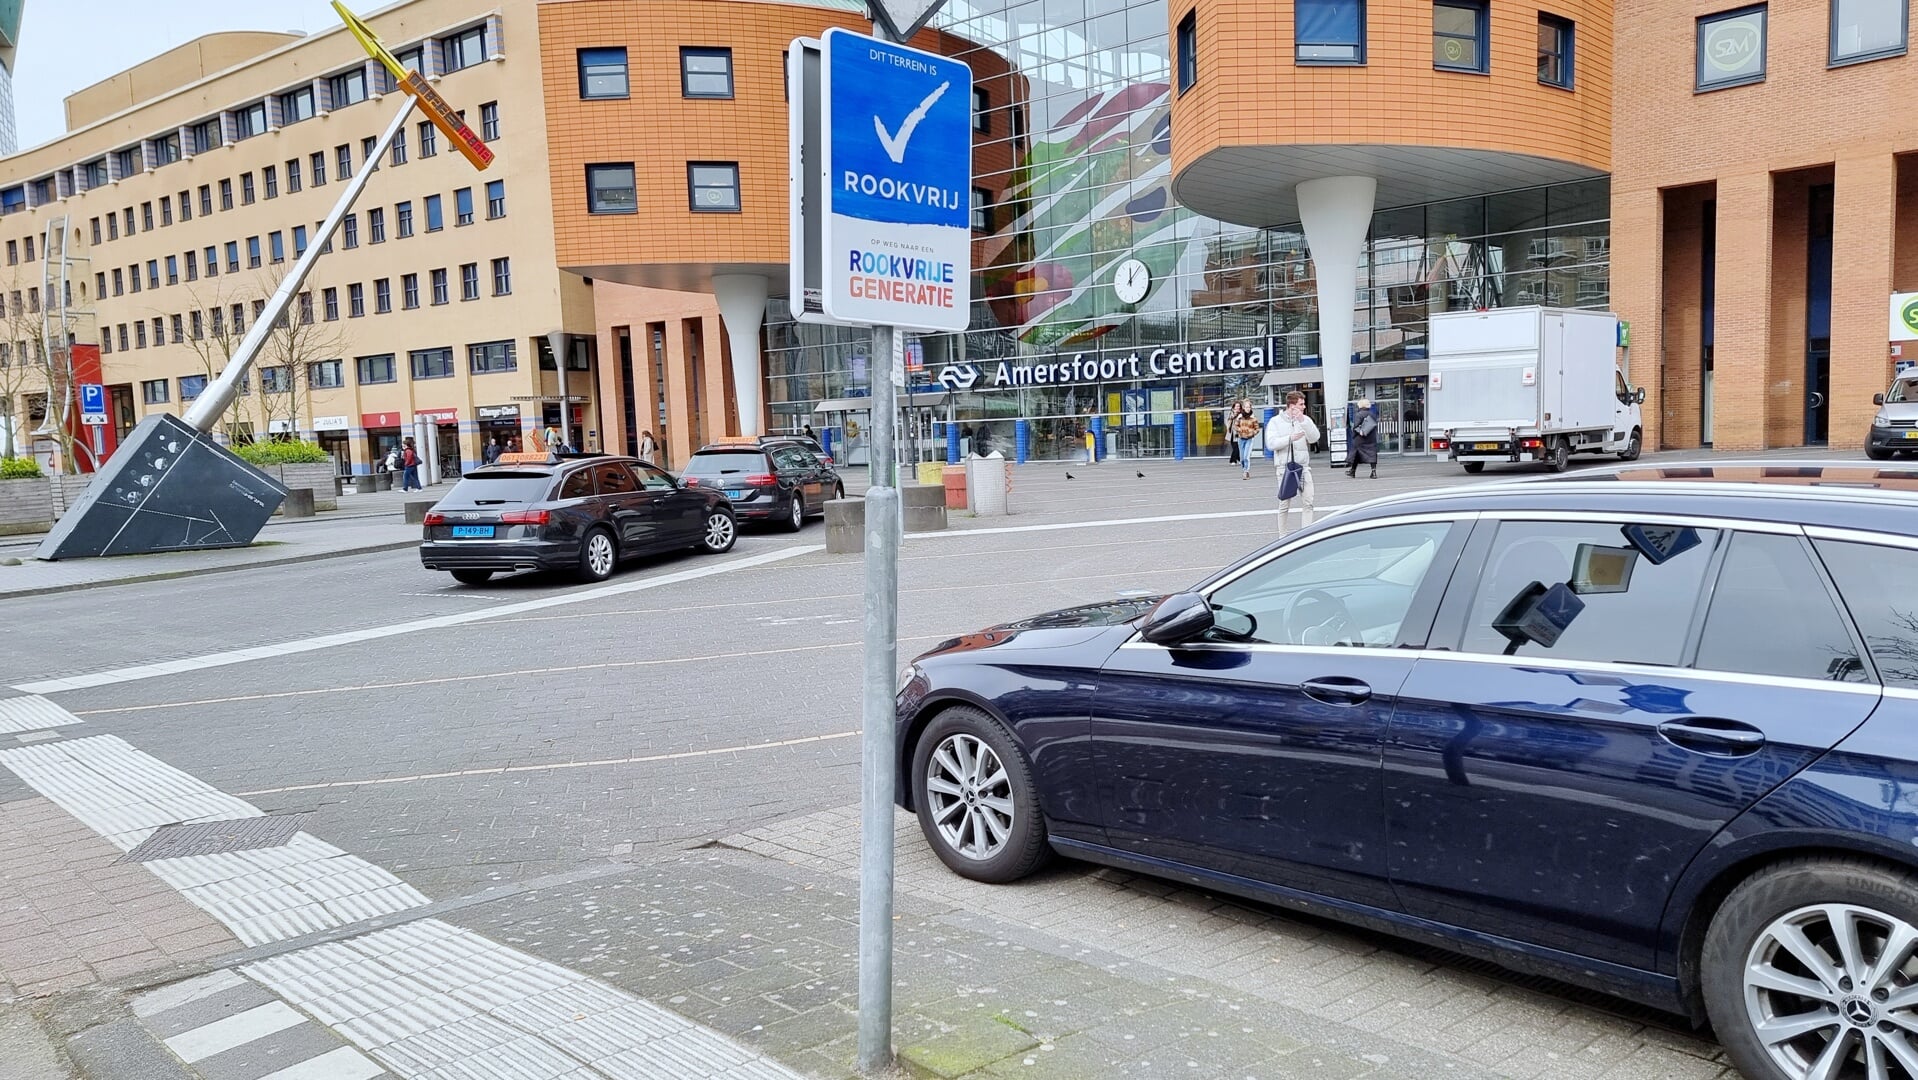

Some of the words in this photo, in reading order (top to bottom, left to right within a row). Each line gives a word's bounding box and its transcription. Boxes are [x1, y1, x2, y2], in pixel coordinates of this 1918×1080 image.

[869, 48, 886, 62] DIT
[888, 53, 927, 75] TERREIN
[929, 64, 937, 76] IS
[844, 170, 959, 210] ROOKVRIJ
[883, 240, 899, 249] WEG
[900, 243, 919, 251] NAAR
[921, 246, 934, 254] EEN
[849, 249, 954, 283] ROOKVRIJE
[849, 276, 953, 308] GENERATIE
[994, 351, 1140, 386] Amersfoort
[1150, 336, 1275, 376] Centraal
[86, 387, 98, 402] P
